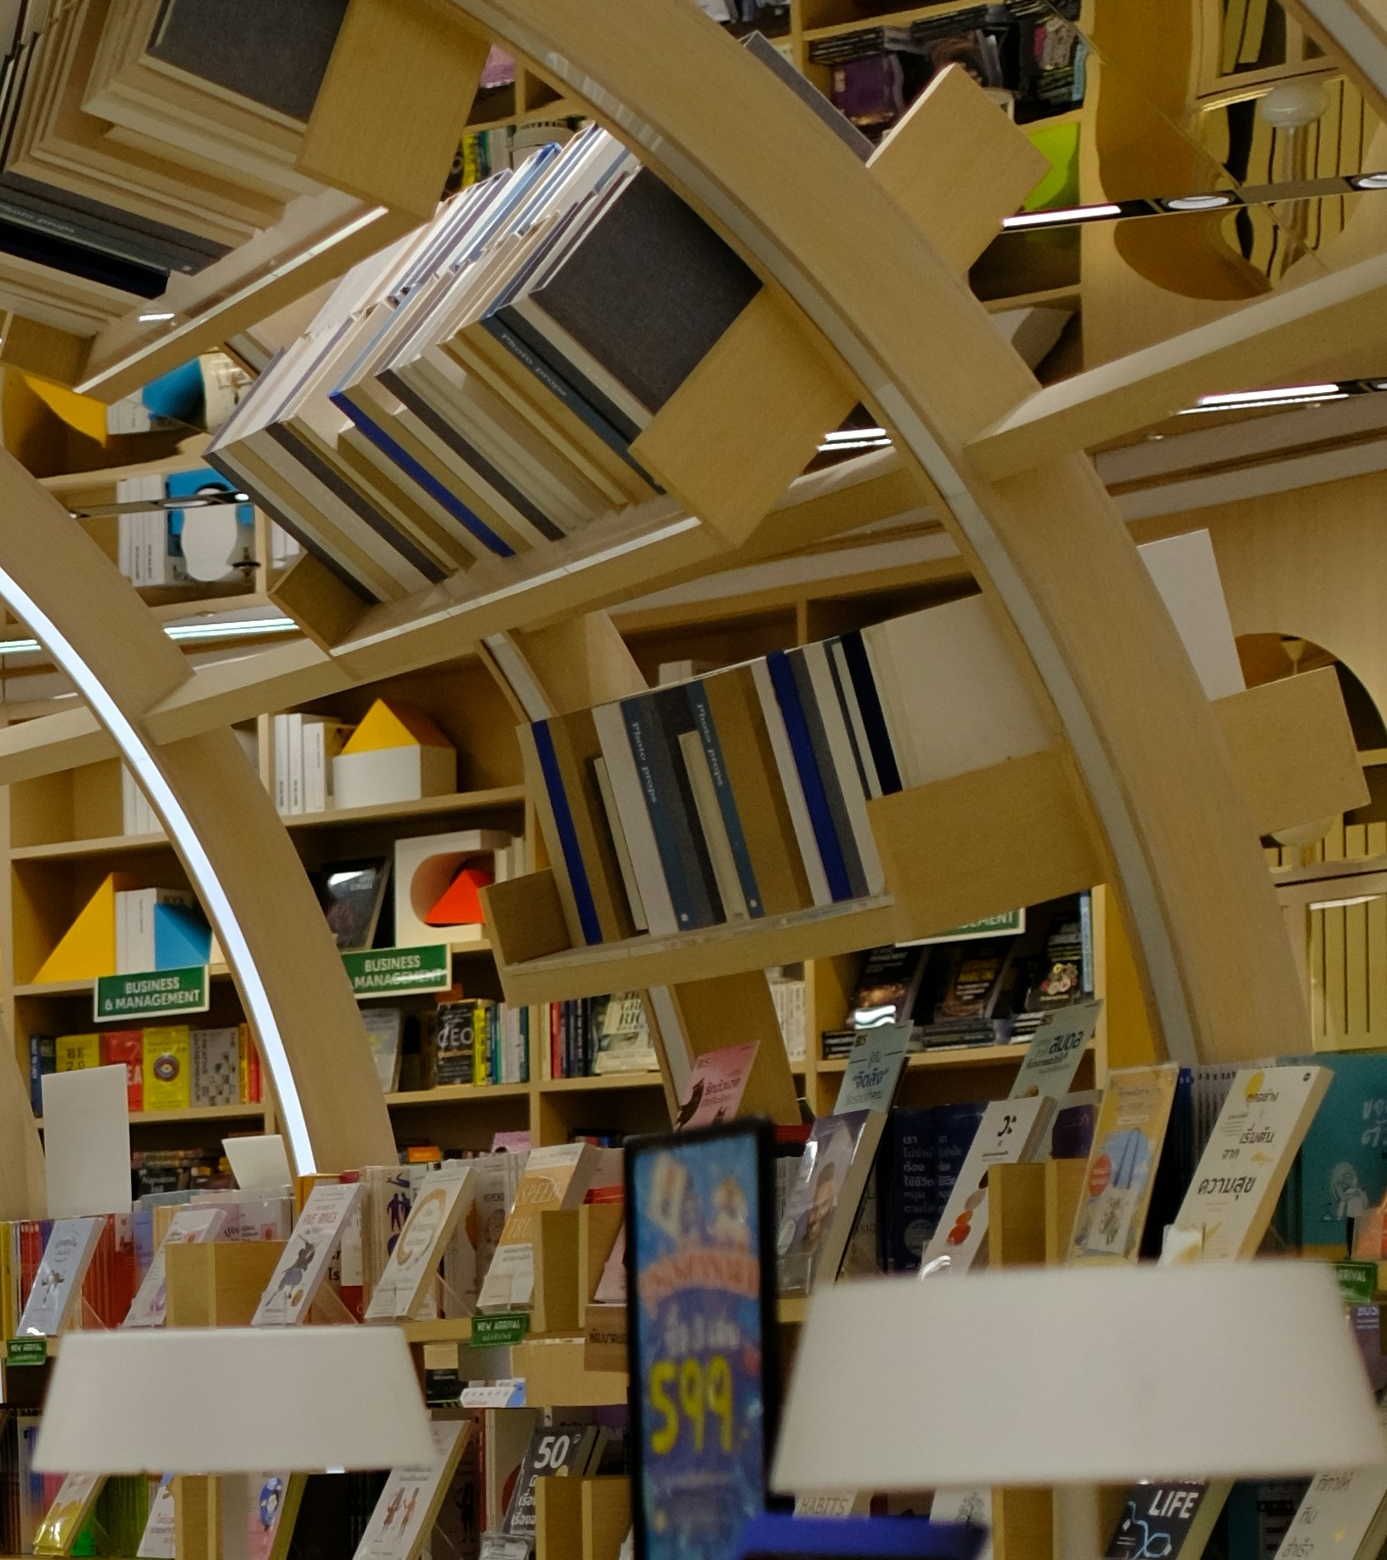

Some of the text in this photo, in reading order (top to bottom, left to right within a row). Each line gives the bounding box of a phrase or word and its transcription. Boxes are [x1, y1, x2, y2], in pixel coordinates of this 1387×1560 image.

[364, 954, 421, 973] BUSINESS
[125, 975, 181, 995] BUSINESS
[355, 968, 447, 989] MANAGEMENT
[104, 988, 202, 1011] & MANAGEMENT
[477, 1318, 521, 1332] NEW ARRIVAL
[648, 1354, 734, 1456] 599
[533, 1435, 570, 1470] 50
[799, 1496, 849, 1517] HABITS
[1148, 1489, 1199, 1519] LIFE
